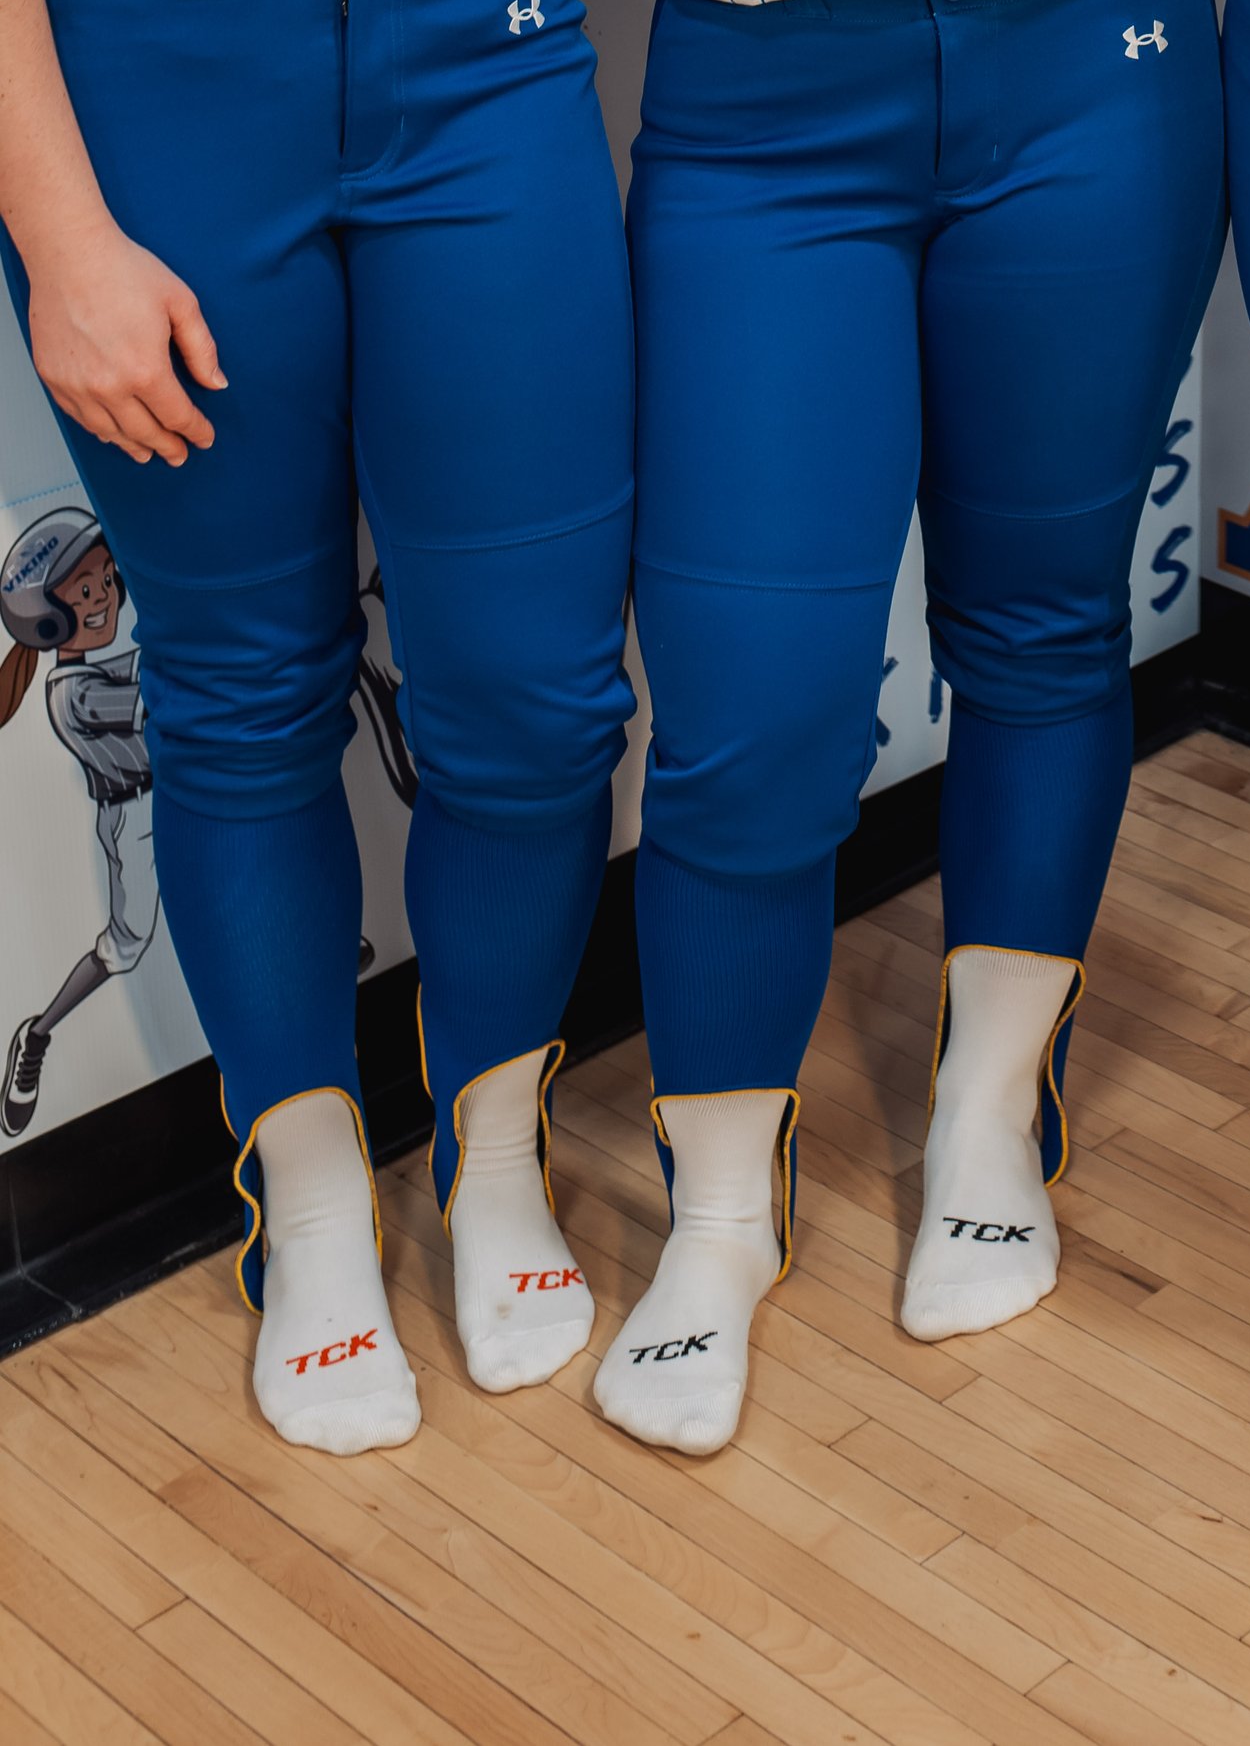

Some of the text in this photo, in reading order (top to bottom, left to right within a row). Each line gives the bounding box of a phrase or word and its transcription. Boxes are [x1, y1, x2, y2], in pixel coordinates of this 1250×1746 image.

[942, 1216, 1036, 1244] TCK
[509, 1266, 585, 1294] TCK
[286, 1328, 378, 1376] TCK
[628, 1331, 719, 1365] TCK
